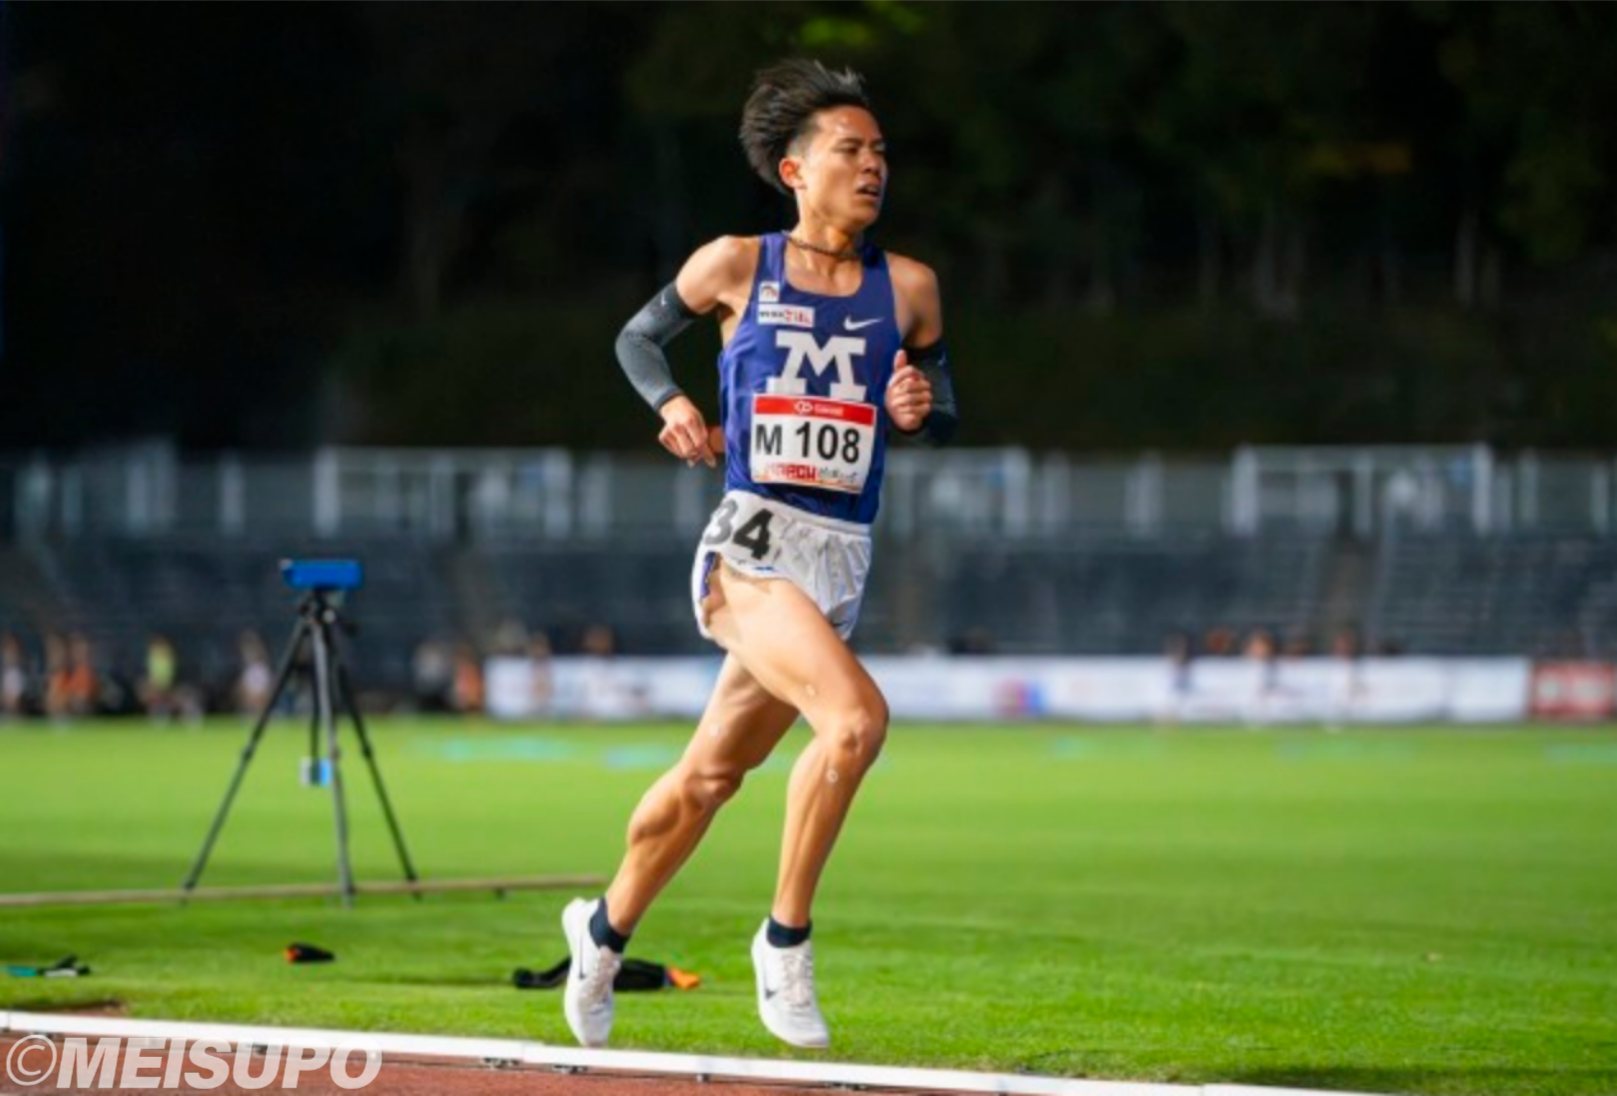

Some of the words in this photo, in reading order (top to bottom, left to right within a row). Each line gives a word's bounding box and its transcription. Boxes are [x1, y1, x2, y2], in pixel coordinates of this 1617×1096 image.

[767, 332, 865, 402] M
[756, 423, 782, 455] M
[795, 421, 860, 464] 108
[703, 497, 775, 561] 34
